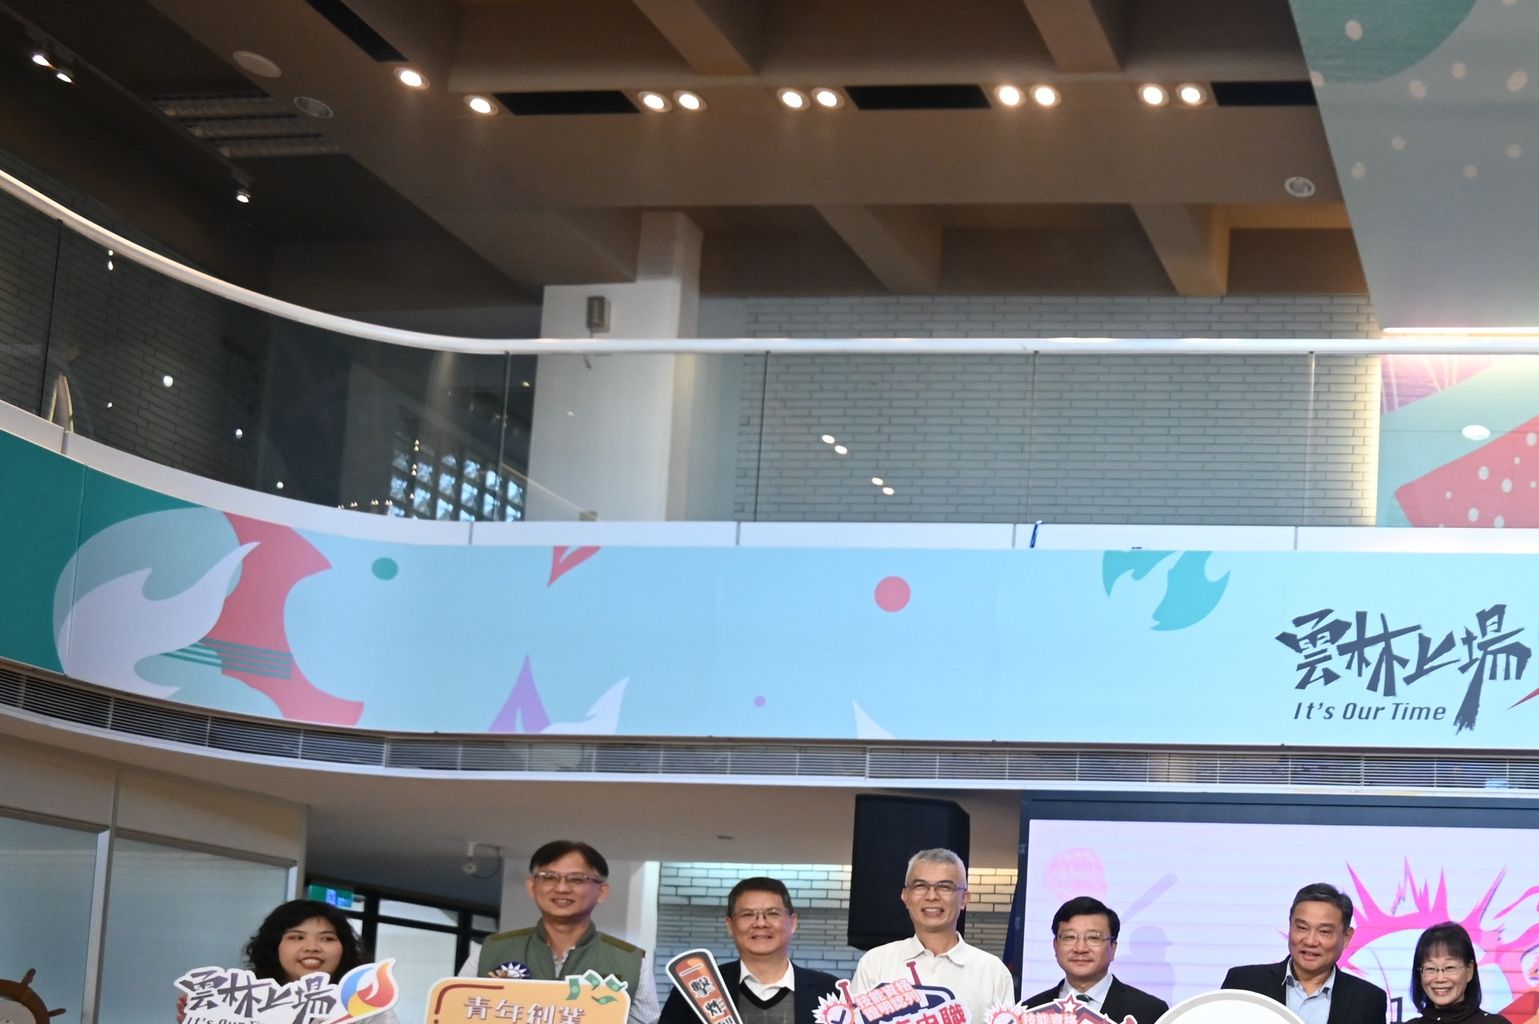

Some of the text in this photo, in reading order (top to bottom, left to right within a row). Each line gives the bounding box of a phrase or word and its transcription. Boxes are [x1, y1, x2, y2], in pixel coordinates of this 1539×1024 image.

[1275, 604, 1532, 734] 雲林上場
[1294, 702, 1446, 721] It's Our Time
